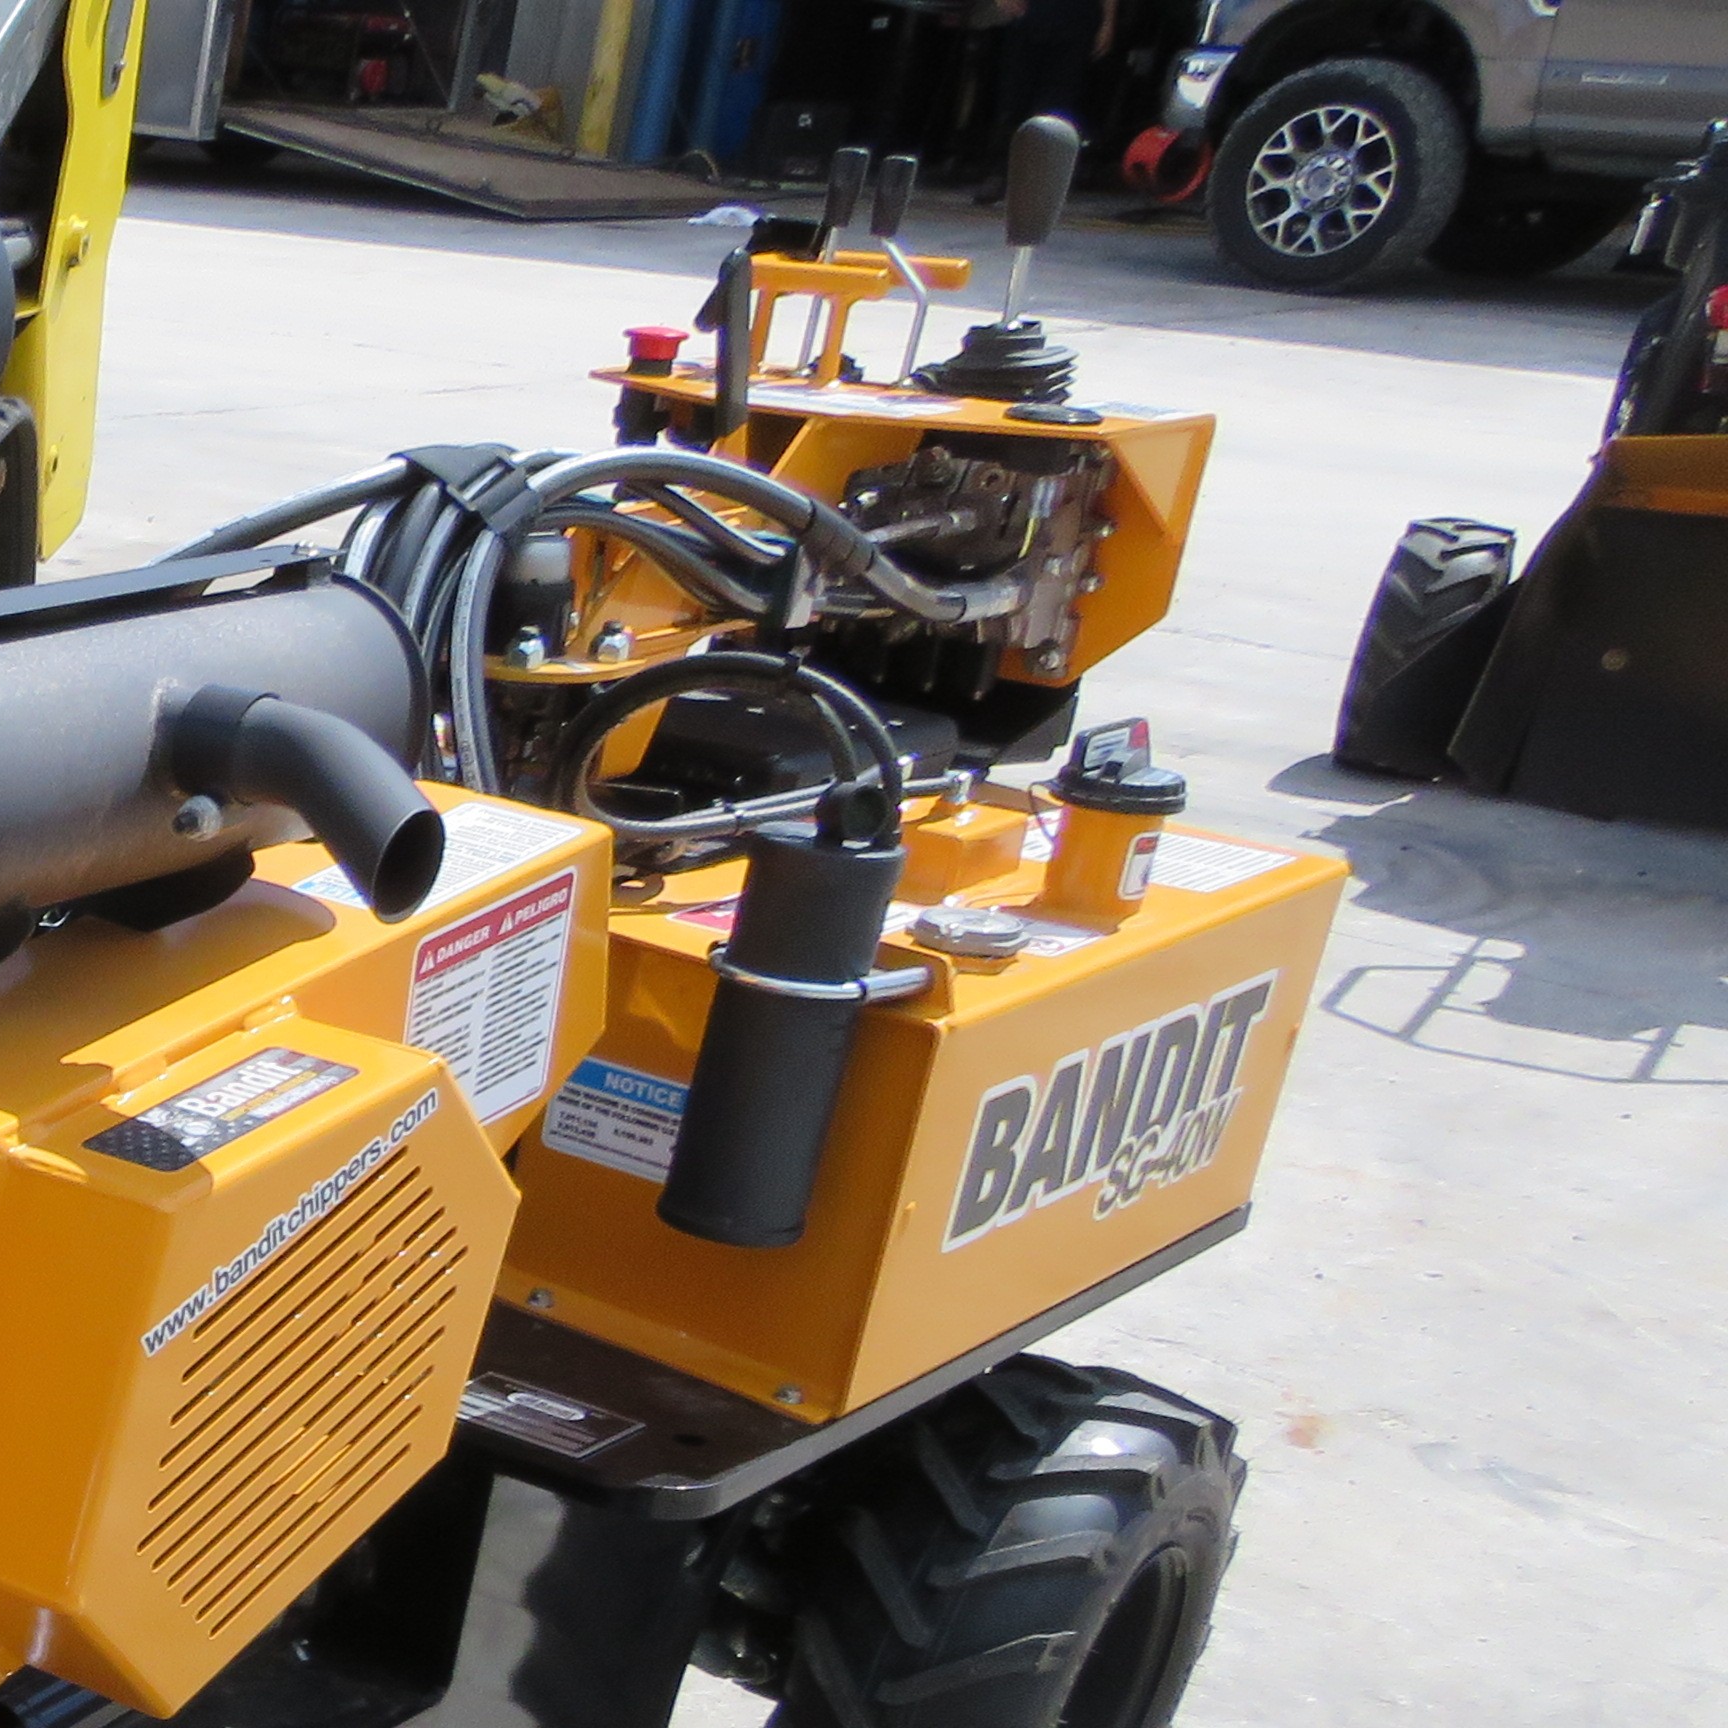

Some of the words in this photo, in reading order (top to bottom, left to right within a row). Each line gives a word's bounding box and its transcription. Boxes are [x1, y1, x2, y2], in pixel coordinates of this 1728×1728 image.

[436, 925, 491, 964] DANGER
[514, 887, 569, 926] PELIGRO
[174, 1059, 303, 1119] Bandit
[604, 1071, 683, 1107] NOTICE
[943, 974, 1277, 1248] BANDIT
[143, 1090, 437, 1355] www.banditchippers.com
